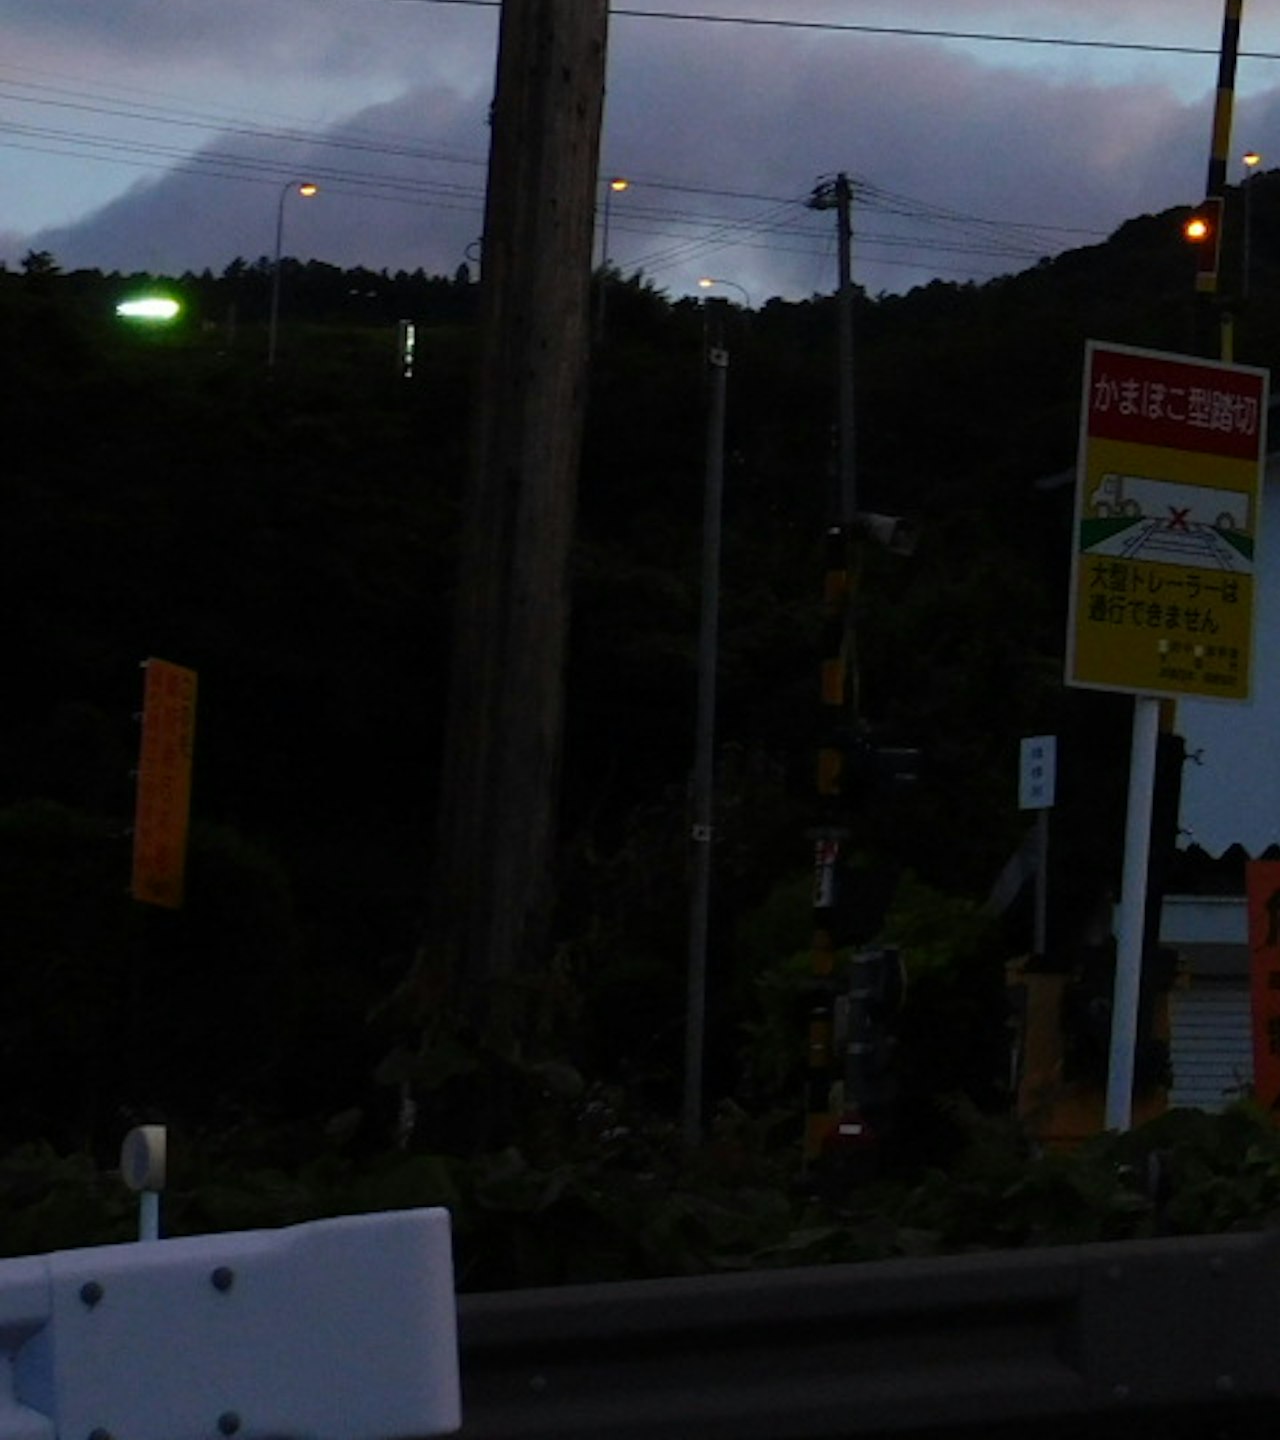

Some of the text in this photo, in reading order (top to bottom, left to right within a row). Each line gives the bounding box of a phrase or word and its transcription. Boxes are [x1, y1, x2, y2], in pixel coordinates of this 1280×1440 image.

[1094, 372, 1258, 436] かまぼこ型踏切
[1089, 561, 1239, 603] 大型トレーラーは
[1088, 593, 1220, 634] 通行できません
